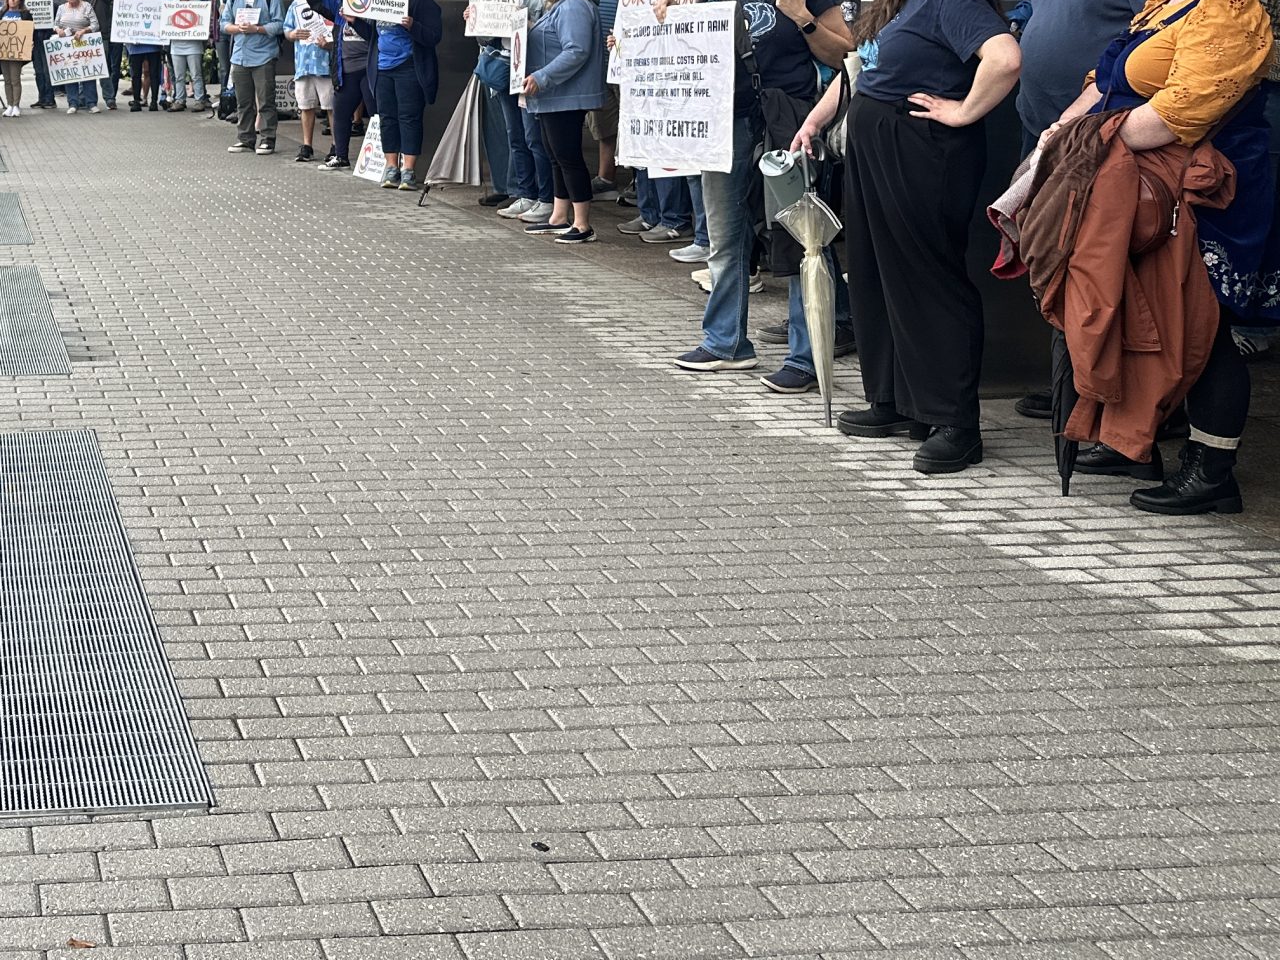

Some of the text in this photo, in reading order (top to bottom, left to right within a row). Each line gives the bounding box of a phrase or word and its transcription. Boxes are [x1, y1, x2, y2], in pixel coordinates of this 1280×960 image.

[674, 21, 695, 34] MAKE
[697, 20, 705, 33] IT
[708, 19, 729, 33] RAIN!
[45, 40, 63, 53] END
[49, 52, 66, 67] AES
[676, 55, 695, 65] COSTS
[696, 54, 708, 64] FOR
[709, 54, 720, 64] US.
[51, 63, 104, 82] UNFAIR PLAY
[679, 71, 690, 81] FOR
[669, 88, 680, 98] NOT
[681, 87, 692, 98] THE
[630, 120, 641, 136] NO
[666, 120, 709, 138] CENTER!
